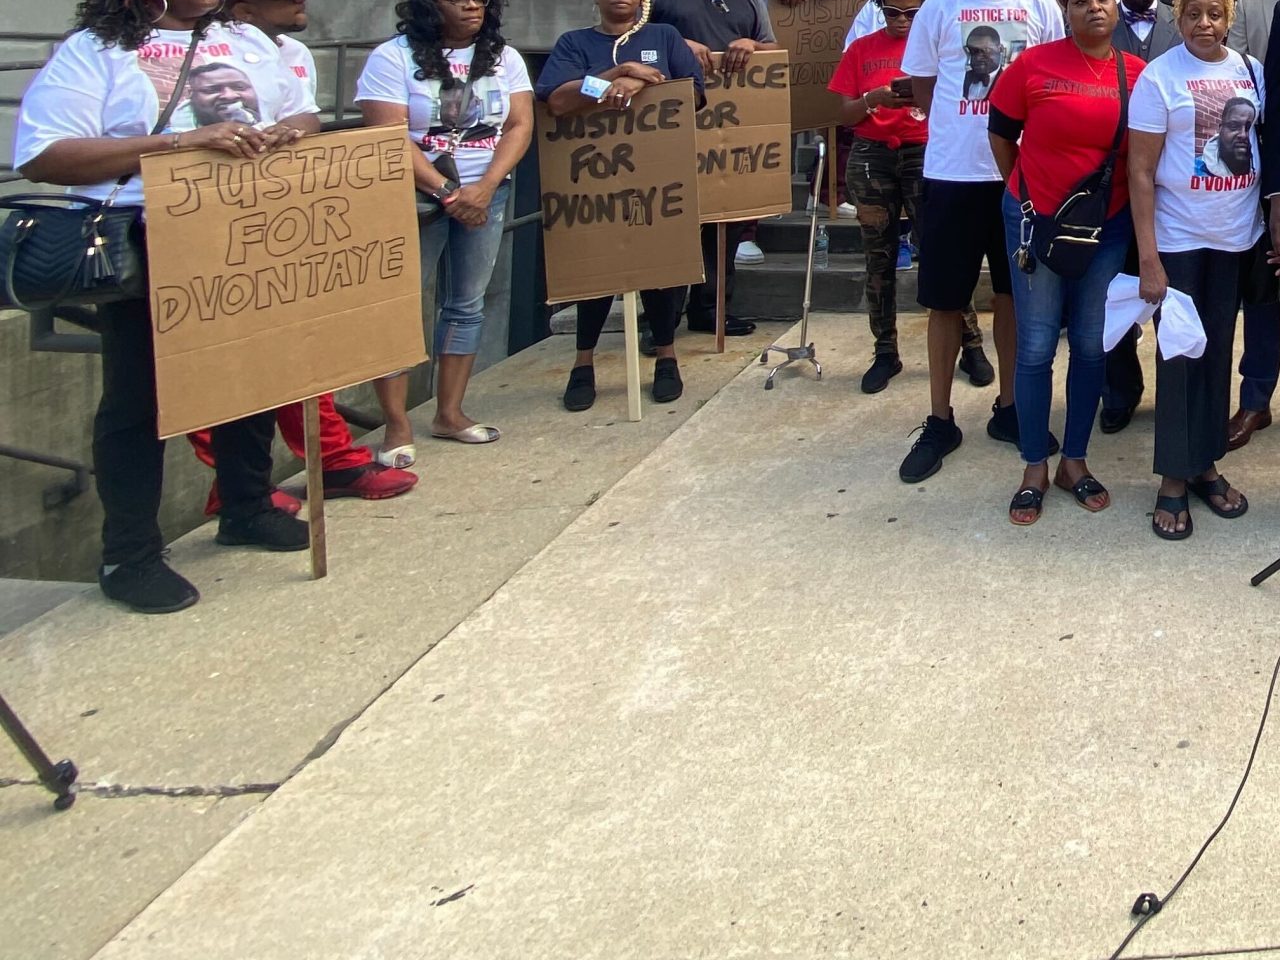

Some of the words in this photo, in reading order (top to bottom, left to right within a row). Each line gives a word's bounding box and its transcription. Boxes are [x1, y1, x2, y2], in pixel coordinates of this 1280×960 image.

[958, 8, 1003, 22] JUSTICE
[1007, 9, 1028, 22] FOR
[796, 26, 845, 55] FOR
[290, 66, 308, 79] OR
[1186, 79, 1232, 90] JUSTICE
[1233, 79, 1254, 90] FOR
[546, 99, 683, 142] JUSTICE
[696, 101, 740, 129] OR
[570, 143, 636, 183] FOR
[697, 142, 781, 175] ONTAYE
[167, 138, 405, 217] JUSTICE
[542, 182, 683, 231] DVONTAYE
[226, 196, 351, 266] FOR
[155, 237, 405, 333] DVONTAYE
